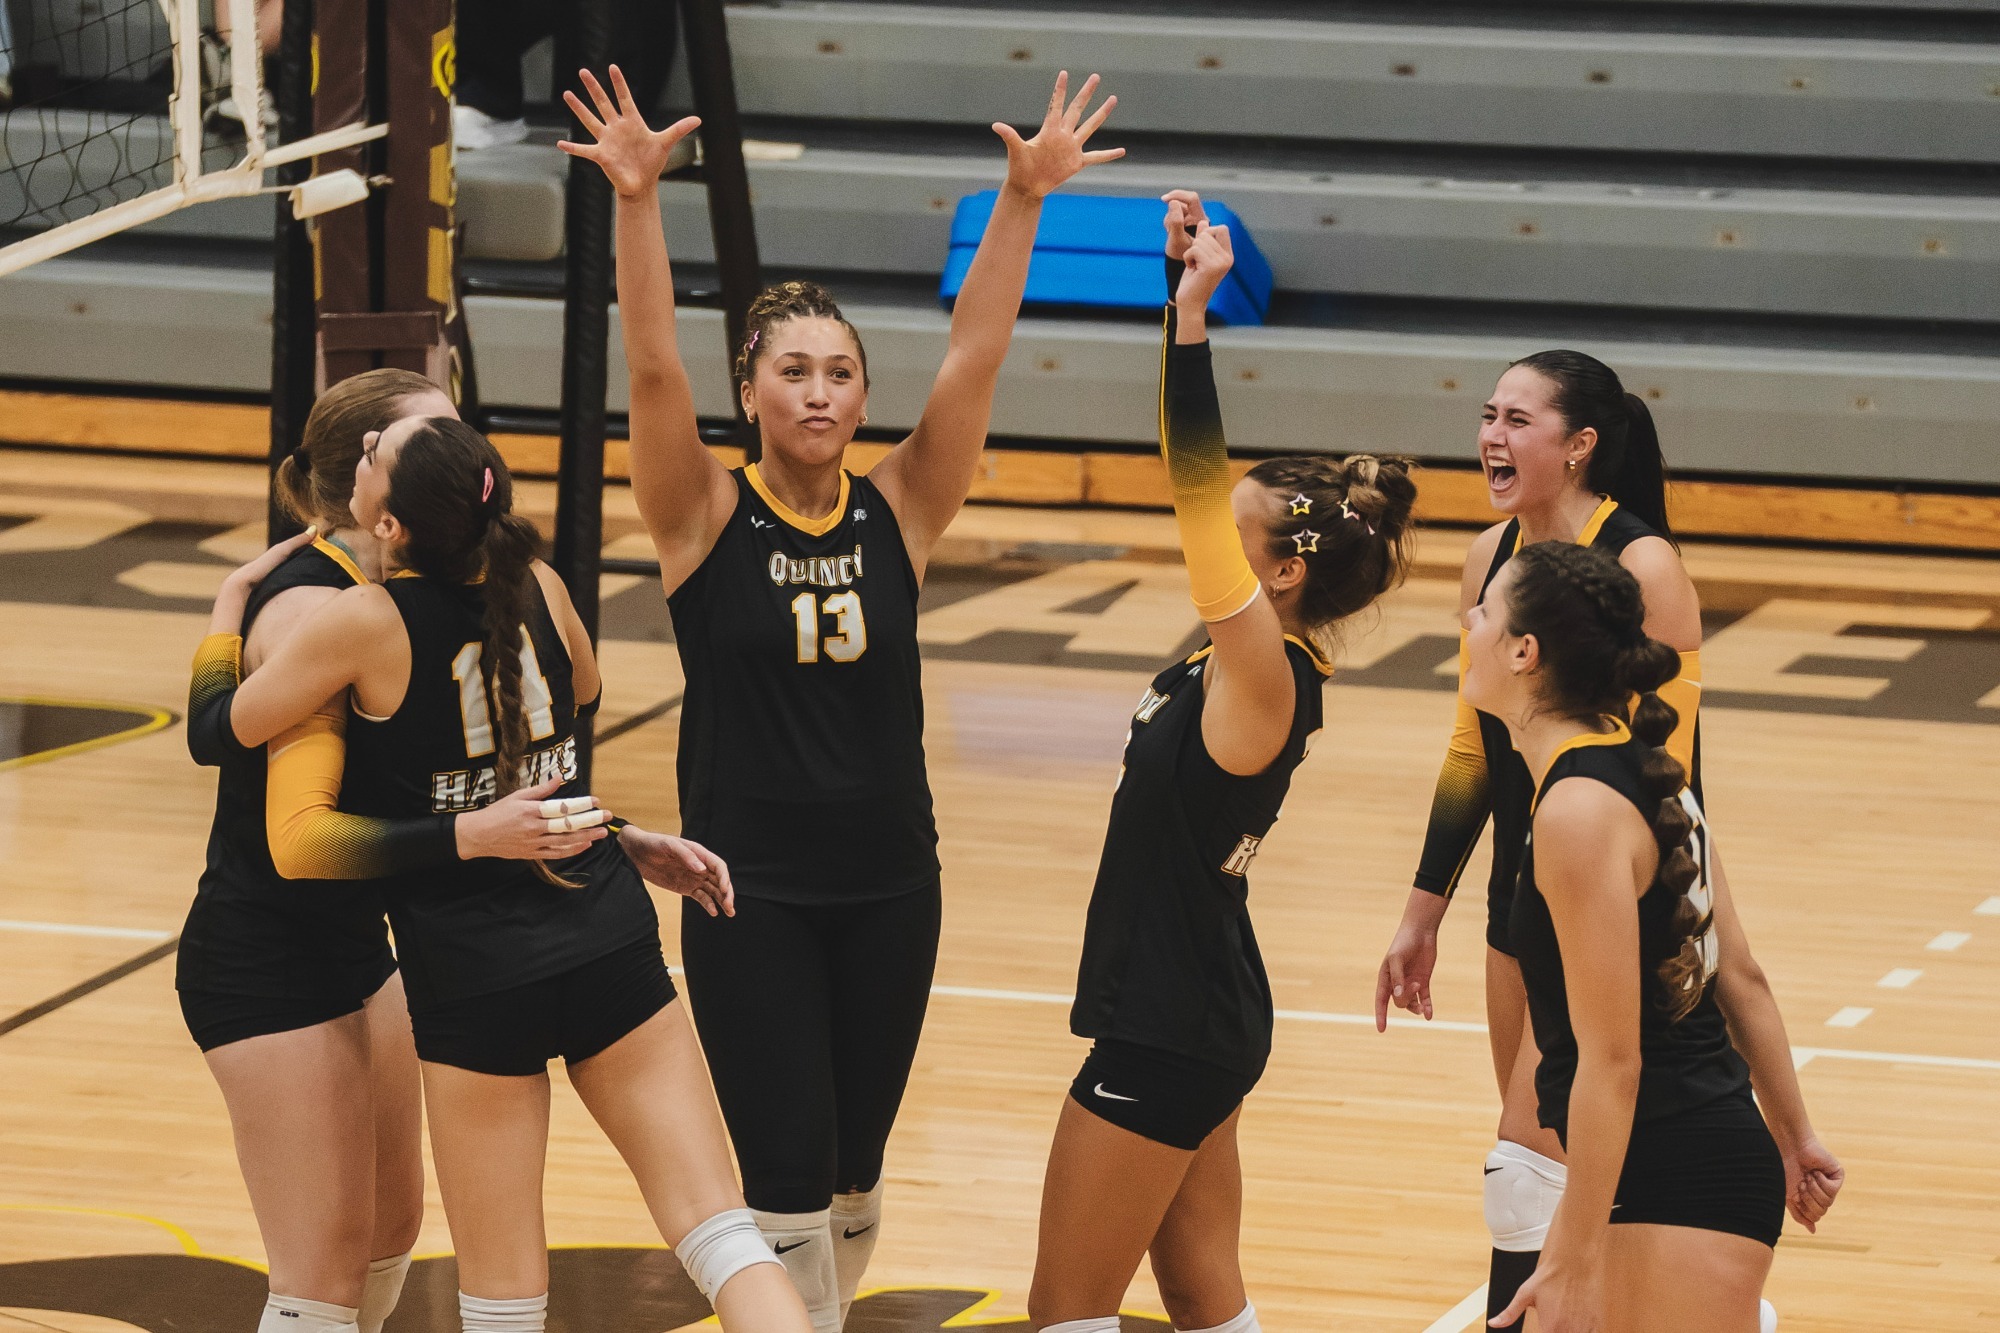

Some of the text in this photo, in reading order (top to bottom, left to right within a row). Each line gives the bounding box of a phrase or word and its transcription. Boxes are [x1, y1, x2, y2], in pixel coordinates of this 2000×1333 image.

[768, 544, 864, 587] QUINCY
[791, 589, 868, 664] 13
[451, 622, 556, 759] 14
